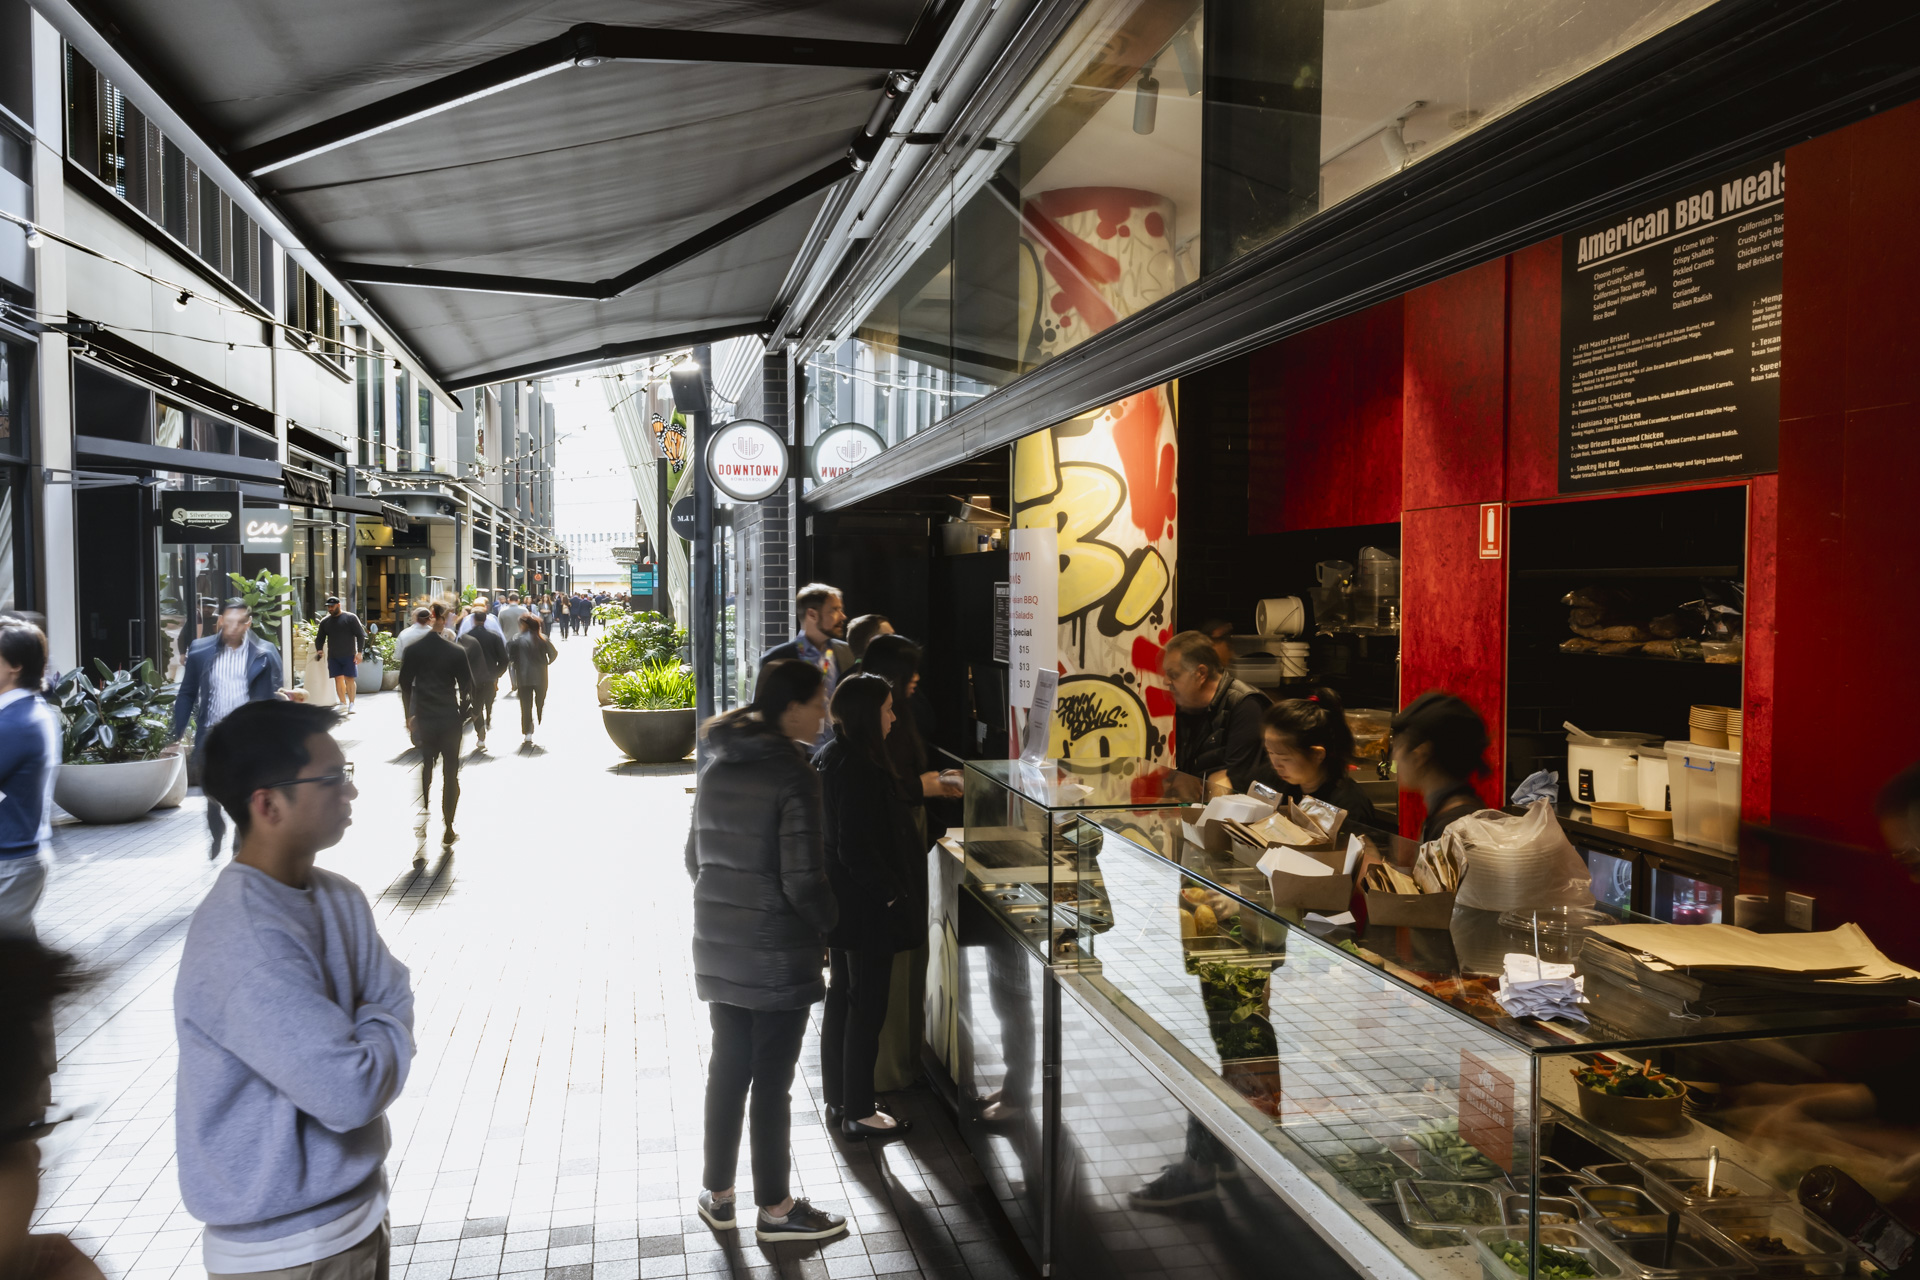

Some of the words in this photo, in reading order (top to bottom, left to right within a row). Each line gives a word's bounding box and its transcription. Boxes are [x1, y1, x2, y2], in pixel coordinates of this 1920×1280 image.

[1578, 208, 1669, 263] American
[1675, 190, 1714, 229] BBQ
[1737, 217, 1772, 233] Californian
[1773, 213, 1785, 222] Tac
[1673, 245, 1681, 255] All
[1681, 241, 1699, 252] Come
[1699, 235, 1715, 246] With
[1737, 234, 1758, 246] Crusty
[1758, 228, 1772, 239] Soft
[1737, 246, 1762, 258] Chicken
[1762, 243, 1770, 251] or
[1771, 239, 1784, 248] Veg
[1673, 255, 1691, 266] Crispy
[1691, 248, 1714, 260] Shallots
[1737, 259, 1752, 271] Beef
[1752, 254, 1775, 266] Brisket
[1775, 251, 1784, 260] or
[1593, 270, 1611, 280] Choose
[1611, 266, 1625, 274] From
[1673, 264, 1693, 276] Pickled
[1693, 259, 1715, 270] Carrots
[1593, 282, 1607, 291] Tiger
[1606, 277, 1623, 287] Crusty
[1622, 272, 1634, 282] Soft
[1634, 268, 1645, 278] Roll
[1672, 277, 1693, 288] Onions
[1593, 288, 1620, 301] Californian
[1620, 284, 1632, 292] Taco
[1631, 280, 1646, 289] Wrap
[1593, 301, 1607, 311] Salad
[1606, 297, 1620, 307] Bowl
[1619, 292, 1641, 304] (Hawker
[1641, 286, 1657, 297] Style)
[1672, 286, 1700, 298] Coriander
[1672, 299, 1692, 310] Daikon
[1693, 292, 1713, 304] Radish
[1593, 313, 1603, 321] Rice
[1603, 308, 1617, 318] Bowl
[1751, 322, 1768, 331] Lemon
[1589, 338, 1609, 348] Master
[1609, 332, 1630, 343] Brisket
[1760, 336, 1781, 346] Texan
[1578, 370, 1594, 379] South
[1594, 366, 1617, 376] Carolina
[1617, 360, 1638, 371] Brisket
[1578, 398, 1597, 407] Kansas
[1597, 396, 1609, 404] City
[1609, 392, 1632, 401] Chicken
[1577, 419, 1603, 429] Louisiana
[1603, 417, 1618, 425] Spicy
[1618, 412, 1641, 422] Chicken
[1590, 440, 1610, 448] Orleans
[1611, 434, 1640, 445] Blackened
[1640, 432, 1664, 441] Chicken
[718, 464, 779, 476] DOWNTOWN
[1576, 464, 1597, 472] Smokey
[1597, 461, 1607, 469] Hot
[1608, 460, 1620, 468] Bird
[1023, 595, 1039, 606] BBQ
[1015, 611, 1034, 620] Salads
[1012, 628, 1033, 638] Special
[1019, 645, 1030, 654] $15
[1019, 662, 1030, 671] $13
[1019, 679, 1031, 689] $13
[1056, 692, 1096, 713] DOWN
[1058, 698, 1103, 728] TOWN
[1070, 705, 1122, 741] BOWLS
